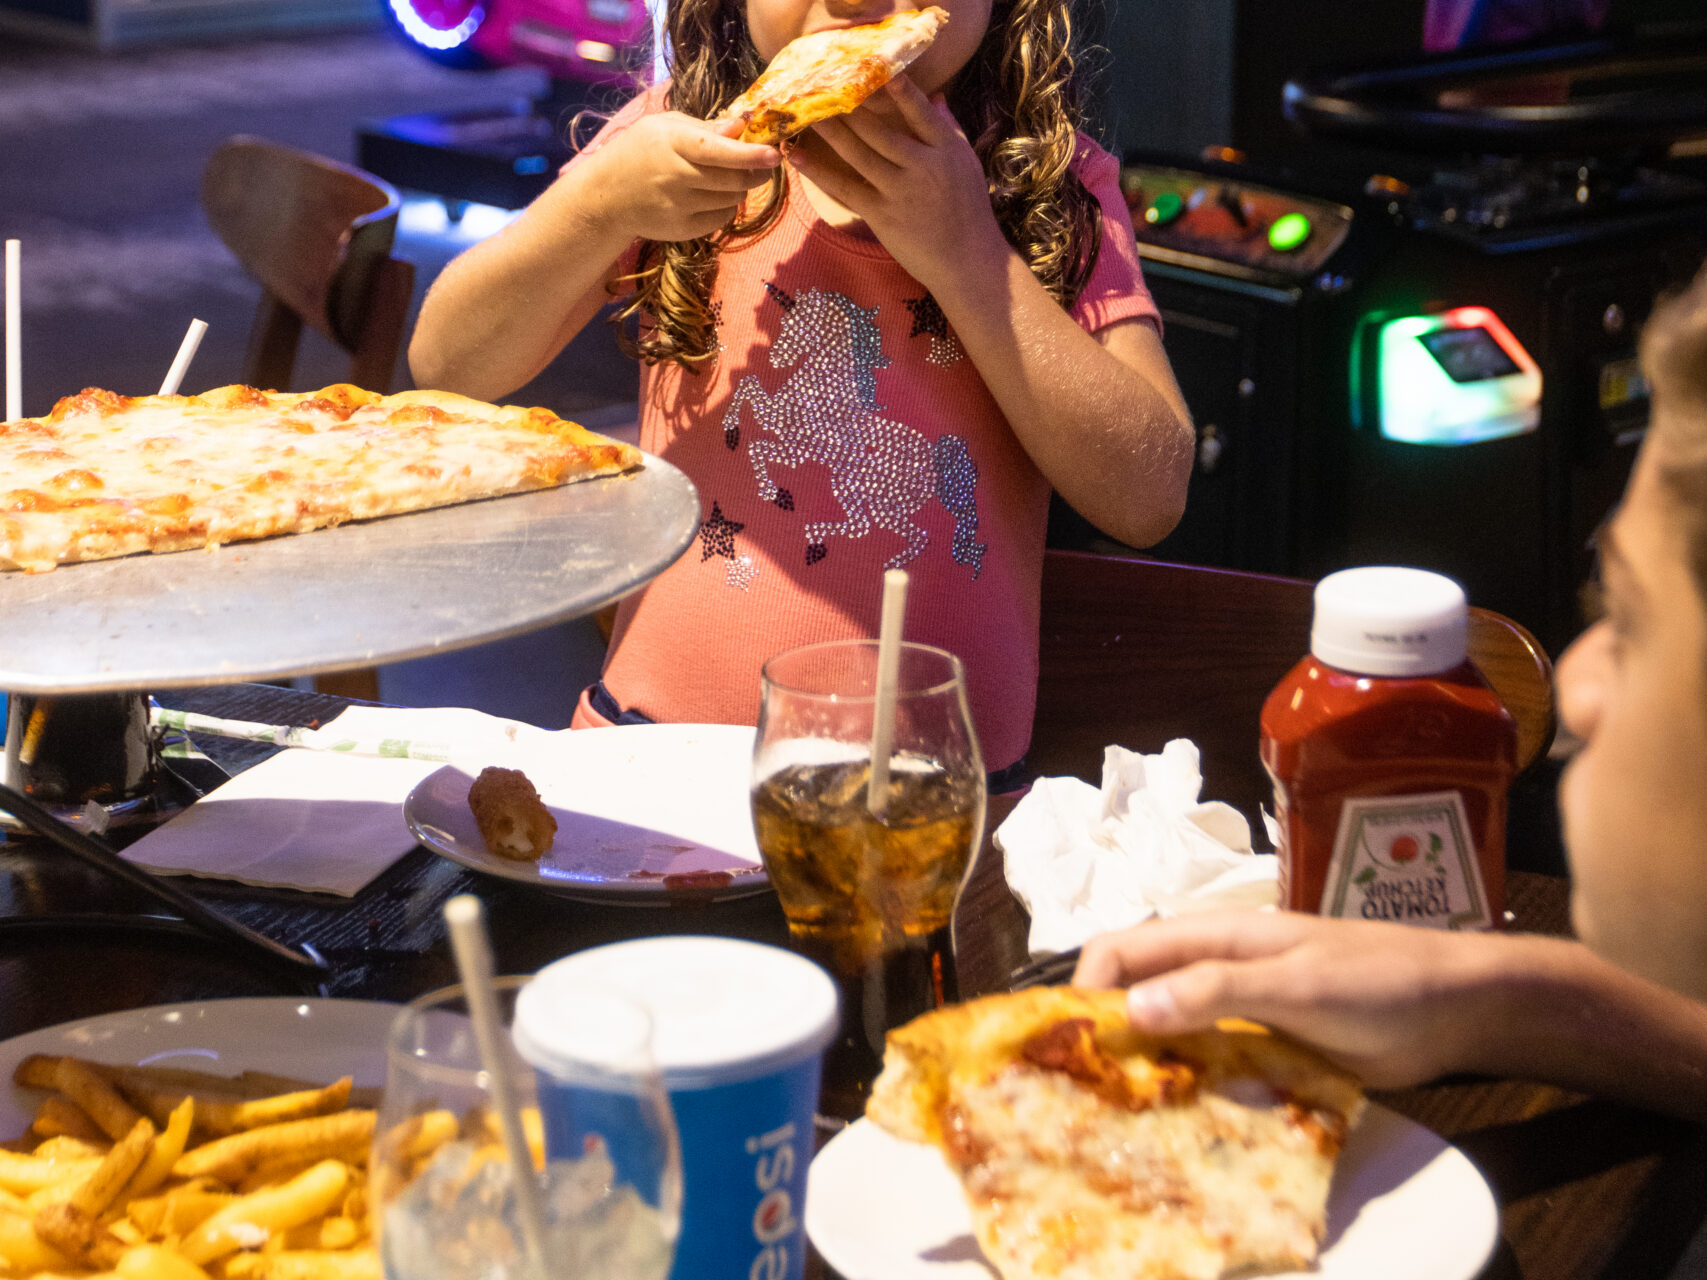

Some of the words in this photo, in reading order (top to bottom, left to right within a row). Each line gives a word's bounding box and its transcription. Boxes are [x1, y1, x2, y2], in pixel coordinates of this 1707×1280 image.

[1365, 877, 1446, 899] KETCHUP
[1361, 896, 1451, 920] TOMATO
[746, 1123, 796, 1280] epsi
